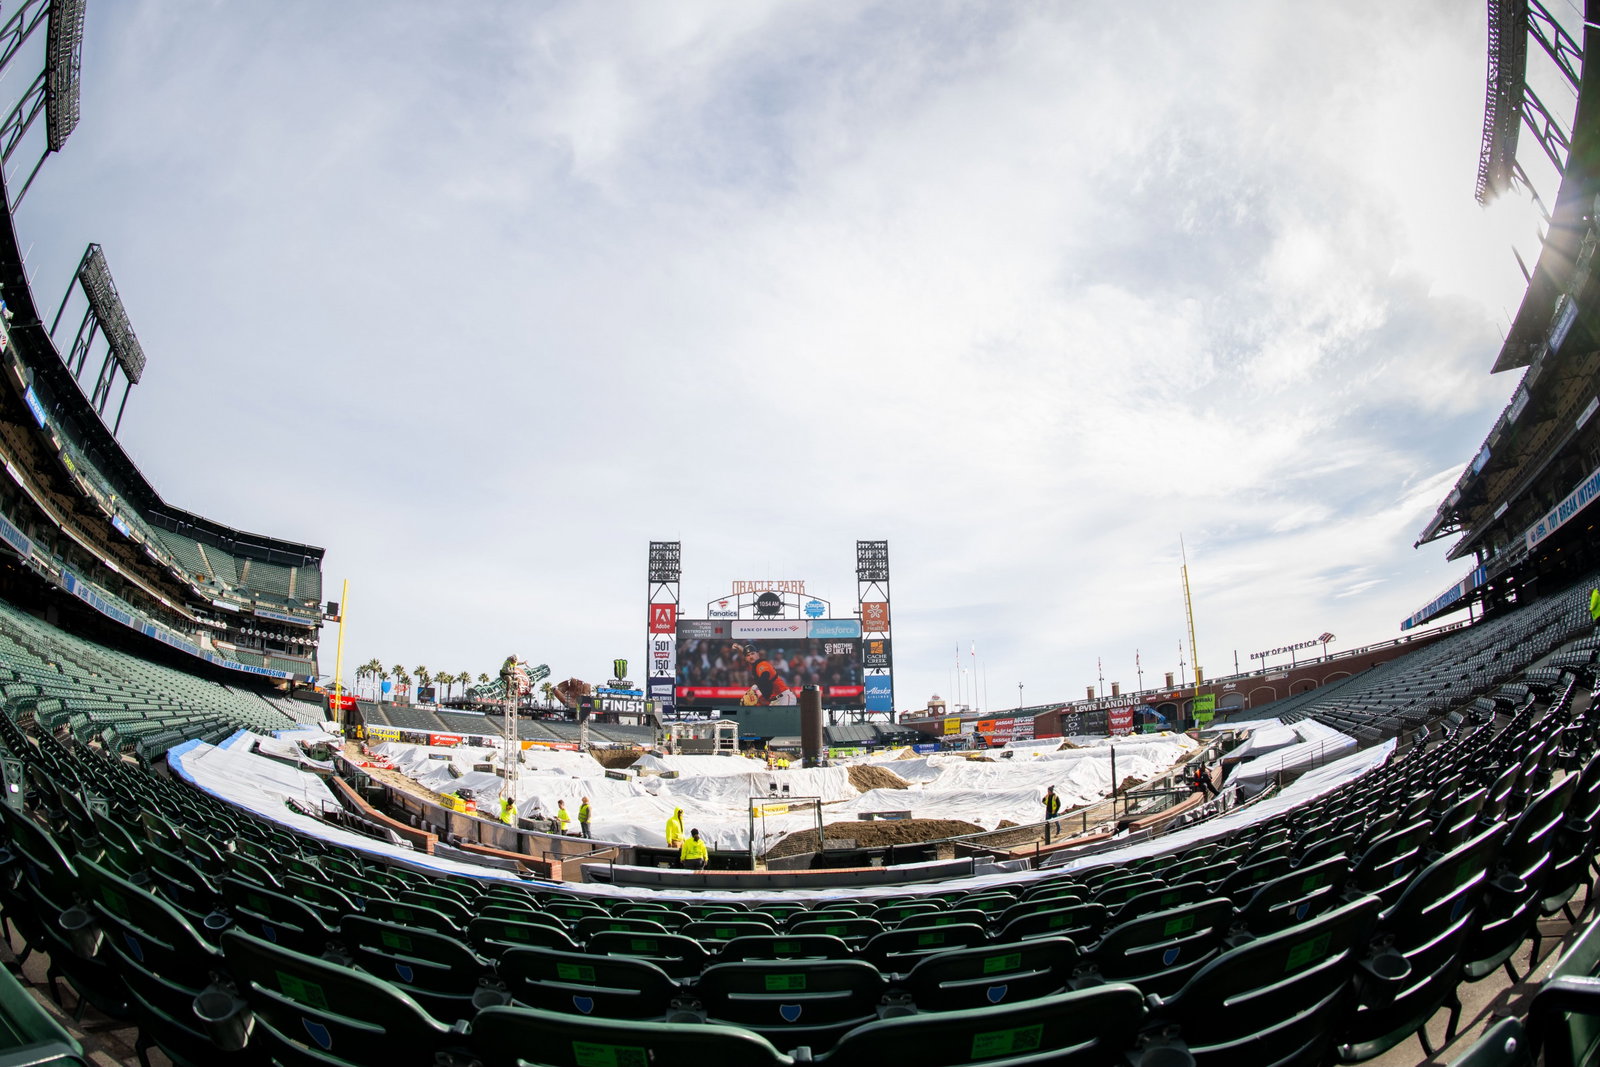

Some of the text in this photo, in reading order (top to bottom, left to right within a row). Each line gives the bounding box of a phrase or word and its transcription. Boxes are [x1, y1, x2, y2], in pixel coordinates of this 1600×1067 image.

[1548, 510, 1558, 530] TOY
[1558, 495, 1578, 522] BREAK
[733, 581, 805, 595] ORACLE PARK
[816, 626, 855, 635] salesforce
[655, 641, 669, 651] 501
[1250, 650, 1270, 660] BANK
[1283, 640, 1317, 652] AMERICA
[243, 663, 287, 678] INTERMISSION
[655, 660, 669, 670] 150
[602, 700, 644, 712] FINISH
[1100, 698, 1140, 709] LANDING
[369, 728, 399, 736] SUZUKI
